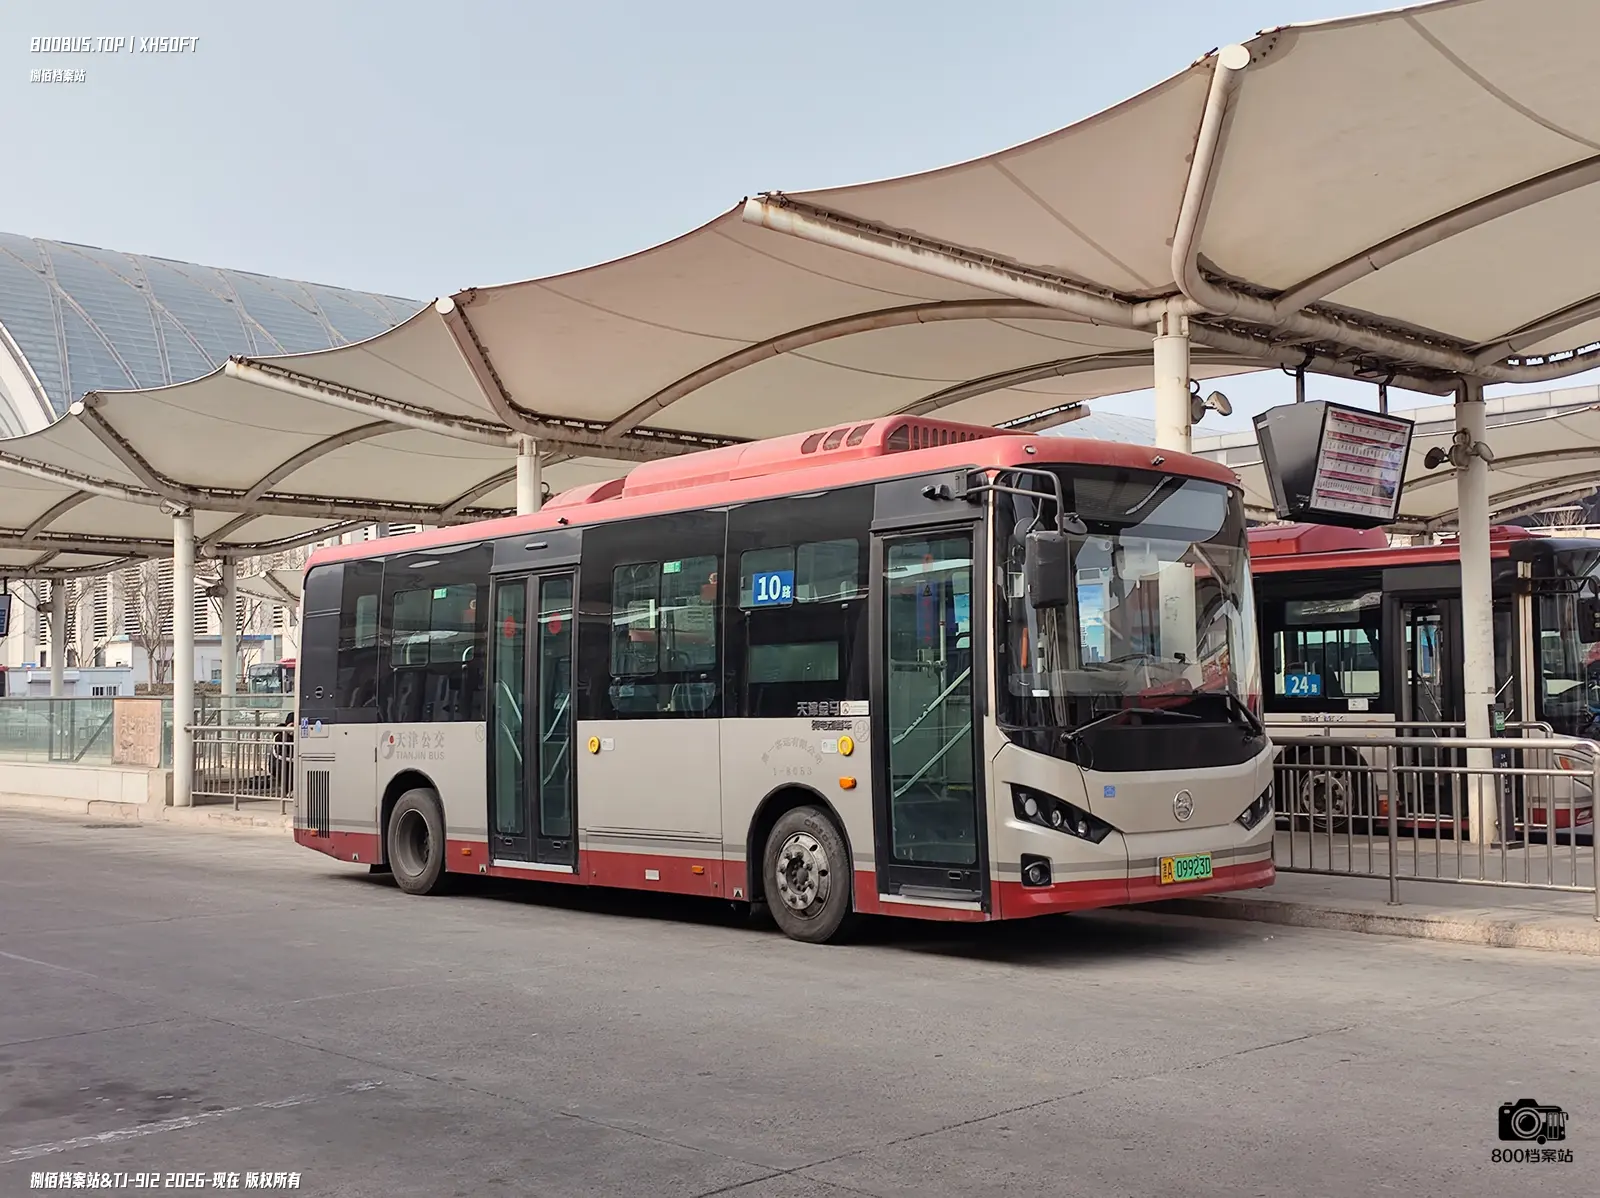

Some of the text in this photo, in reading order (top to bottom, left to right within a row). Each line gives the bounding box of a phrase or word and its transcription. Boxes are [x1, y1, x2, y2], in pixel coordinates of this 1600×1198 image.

[757, 575, 791, 600] 10路
[396, 731, 445, 749] 天津公交
[396, 751, 445, 760] TIANJIN BUS
